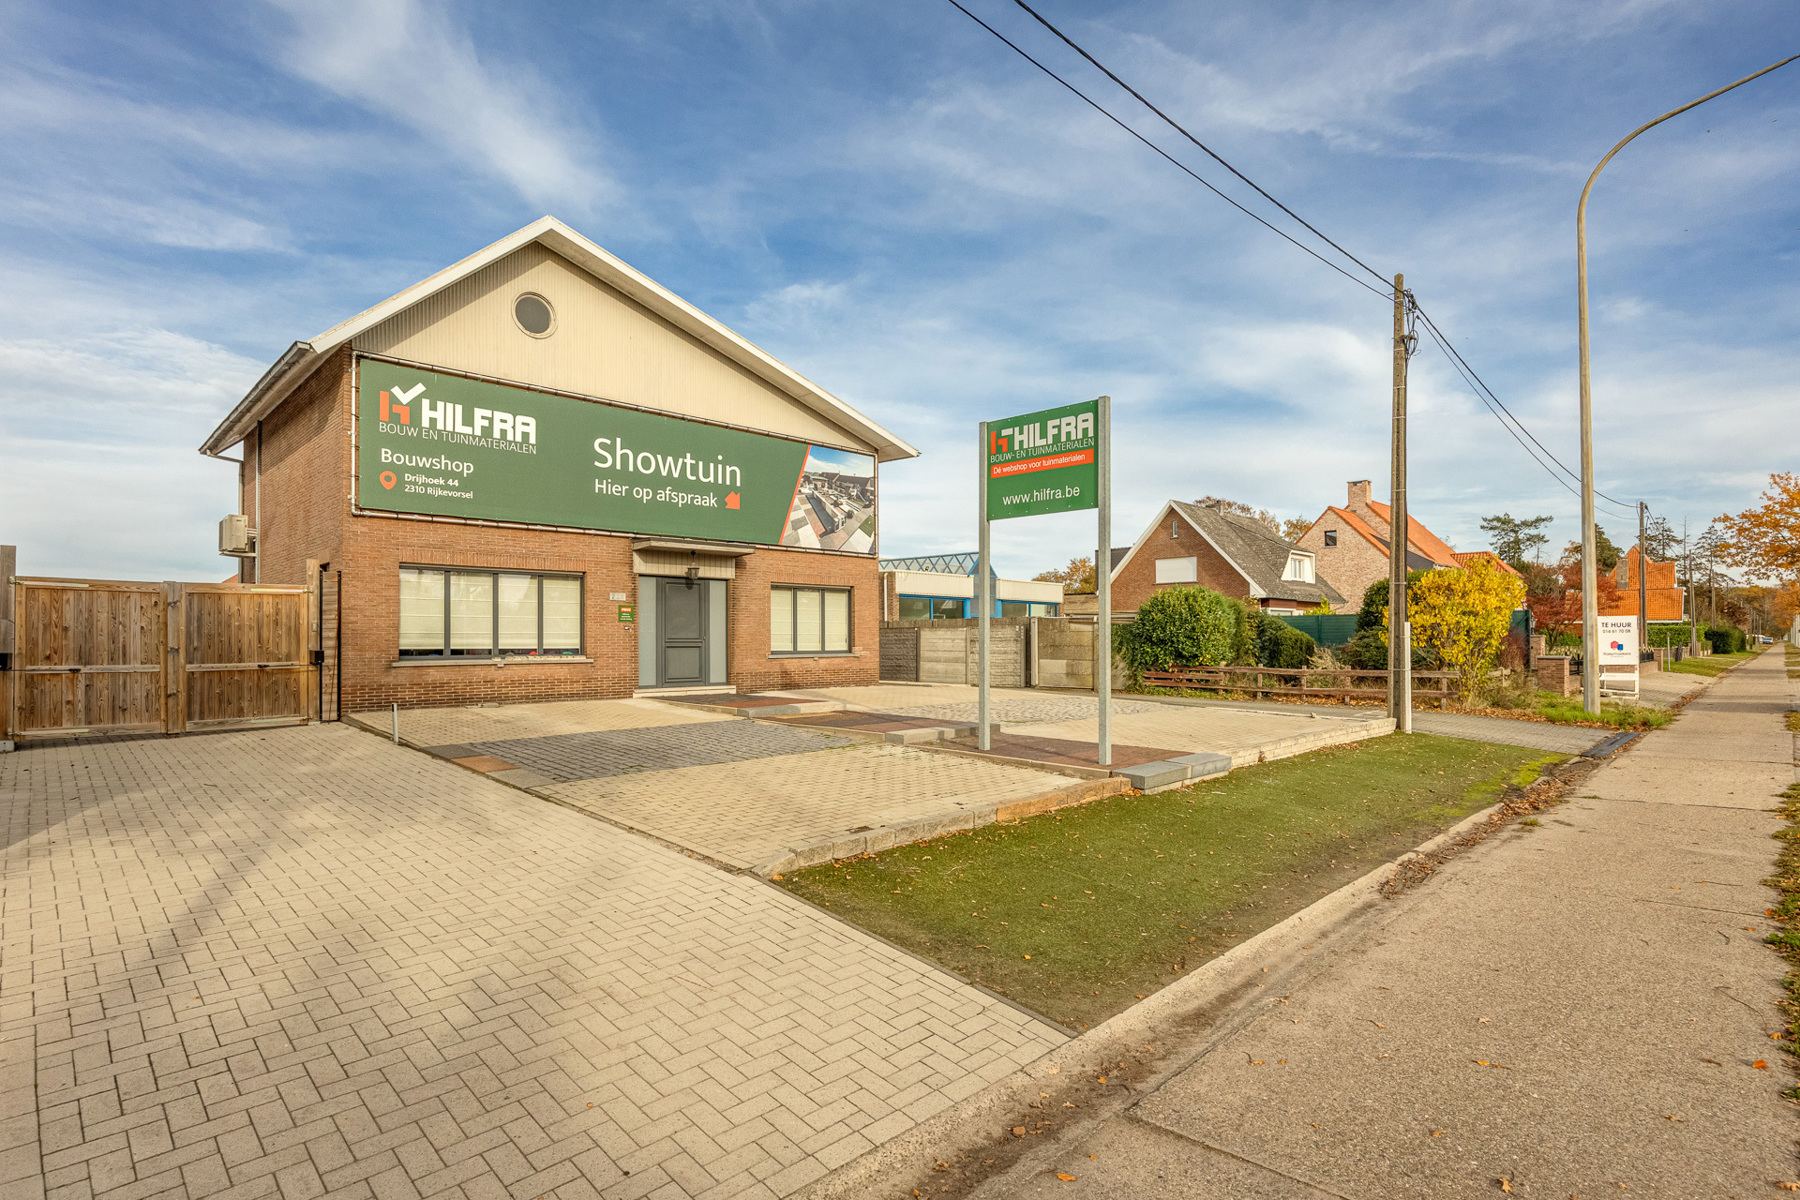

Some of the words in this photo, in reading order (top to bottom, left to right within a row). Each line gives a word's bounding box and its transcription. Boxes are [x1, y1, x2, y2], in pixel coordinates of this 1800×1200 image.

[421, 398, 536, 444] HILFRA
[1014, 412, 1094, 451] HILFRA
[379, 421, 418, 437] BOUW
[422, 429, 439, 441] EN
[442, 432, 537, 455] TUINMATERIALEN
[1016, 450, 1026, 459] EN
[1028, 438, 1094, 456] TUINMATERIALEN
[381, 448, 474, 477] Bouwshop
[593, 437, 741, 487] Showtuin
[1002, 463, 1028, 473] webshop
[1028, 460, 1042, 468] voor
[1042, 454, 1086, 466] tuinmaterialen
[404, 473, 446, 487] Drijhoek
[447, 478, 459, 487] 44
[404, 484, 425, 495] 2310
[427, 487, 474, 499] Rijkevorsel
[594, 478, 629, 497] Hier
[632, 487, 652, 503] op
[656, 486, 717, 508] afspraak
[1002, 485, 1080, 505] www.hilfra.be
